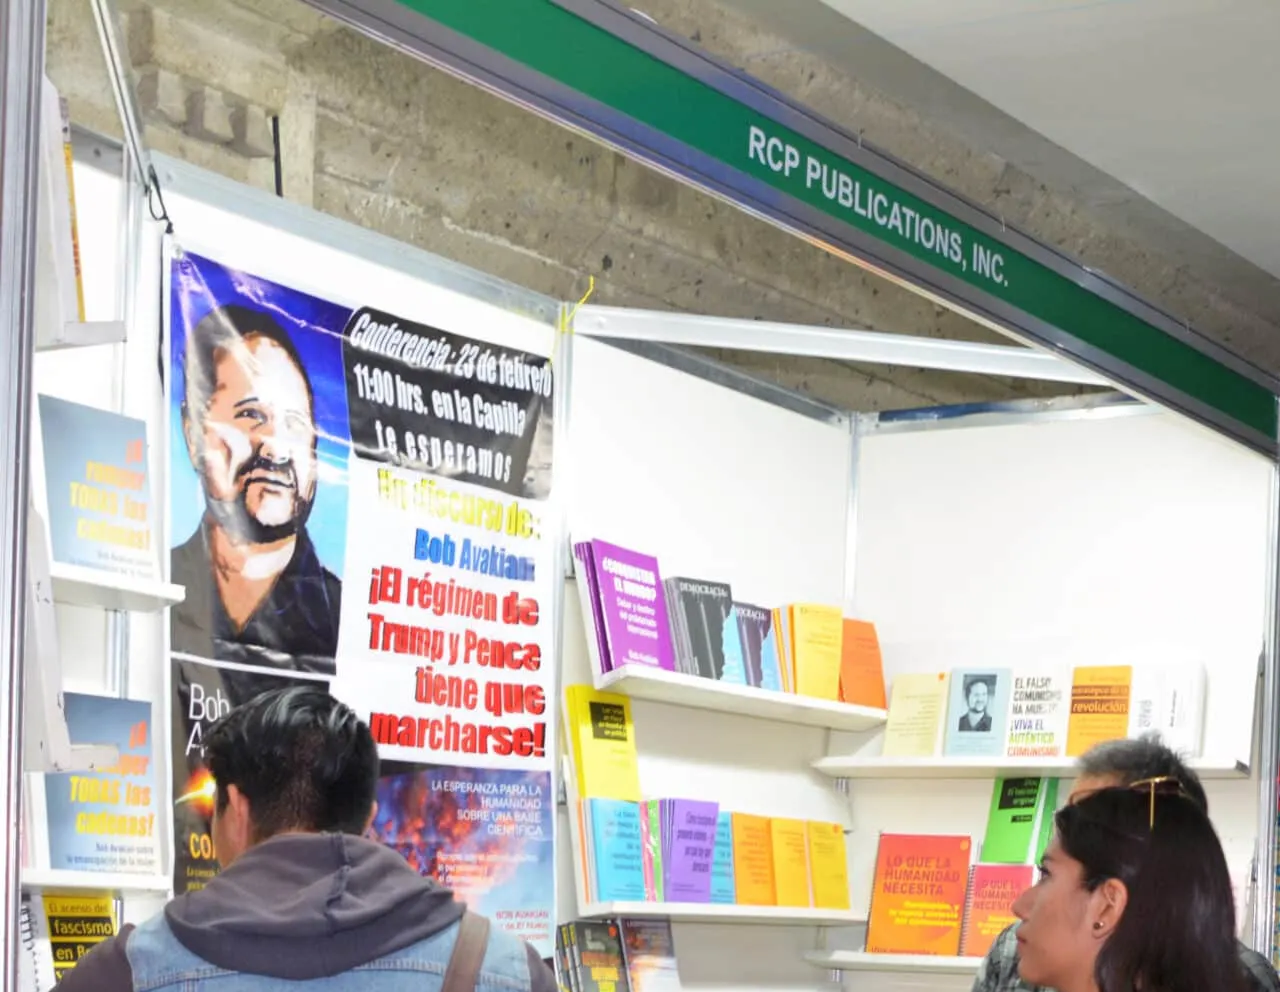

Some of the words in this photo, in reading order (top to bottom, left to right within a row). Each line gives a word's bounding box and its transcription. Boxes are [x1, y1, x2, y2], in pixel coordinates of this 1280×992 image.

[749, 125, 800, 177] RCP
[806, 156, 967, 271] PUBLICATIONS,
[972, 243, 1009, 287] INC.
[454, 343, 479, 379] 23
[476, 349, 497, 384] de
[499, 353, 551, 398] febrero
[353, 362, 394, 407] 11:00
[396, 373, 428, 415] hrs.
[432, 389, 455, 421] en
[455, 389, 472, 425] la
[472, 393, 526, 437] Capilla
[375, 419, 398, 457] te
[404, 431, 512, 483] esperamos
[414, 528, 455, 567] Bob
[369, 565, 402, 605] ¡El
[406, 572, 497, 621] régimen
[502, 591, 539, 626] de
[367, 613, 444, 662] Trump
[448, 632, 459, 666] y
[464, 629, 541, 671] Pence
[1015, 678, 1024, 688] EL
[1027, 677, 1051, 688] FALSO
[415, 666, 478, 710] tiene
[485, 681, 546, 717] que
[188, 683, 230, 722] Bob
[1012, 704, 1023, 714] HA
[1010, 719, 1033, 731] ¡VIVA
[1035, 719, 1044, 730] EL
[370, 712, 546, 757] marcharse!
[1007, 746, 1060, 757] COMUNISMO
[69, 775, 120, 805] TODAS
[125, 781, 151, 806] las
[443, 781, 498, 793] ESPERANZA
[500, 784, 527, 794] PARA
[528, 784, 541, 795] LA
[481, 797, 541, 809] HUMANIDAD
[457, 810, 489, 821] SOBRE
[491, 811, 512, 822] UNA
[514, 811, 541, 822] BASE
[75, 811, 154, 837] cadenas!
[487, 824, 543, 836] CIENTÍFICA
[886, 855, 902, 867] LO
[906, 856, 932, 868] QUE
[935, 857, 951, 868] LA
[884, 869, 960, 882] HUMANIDAD
[883, 882, 944, 896] NECESITA
[54, 919, 112, 934] fascismo
[56, 948, 73, 961] en
